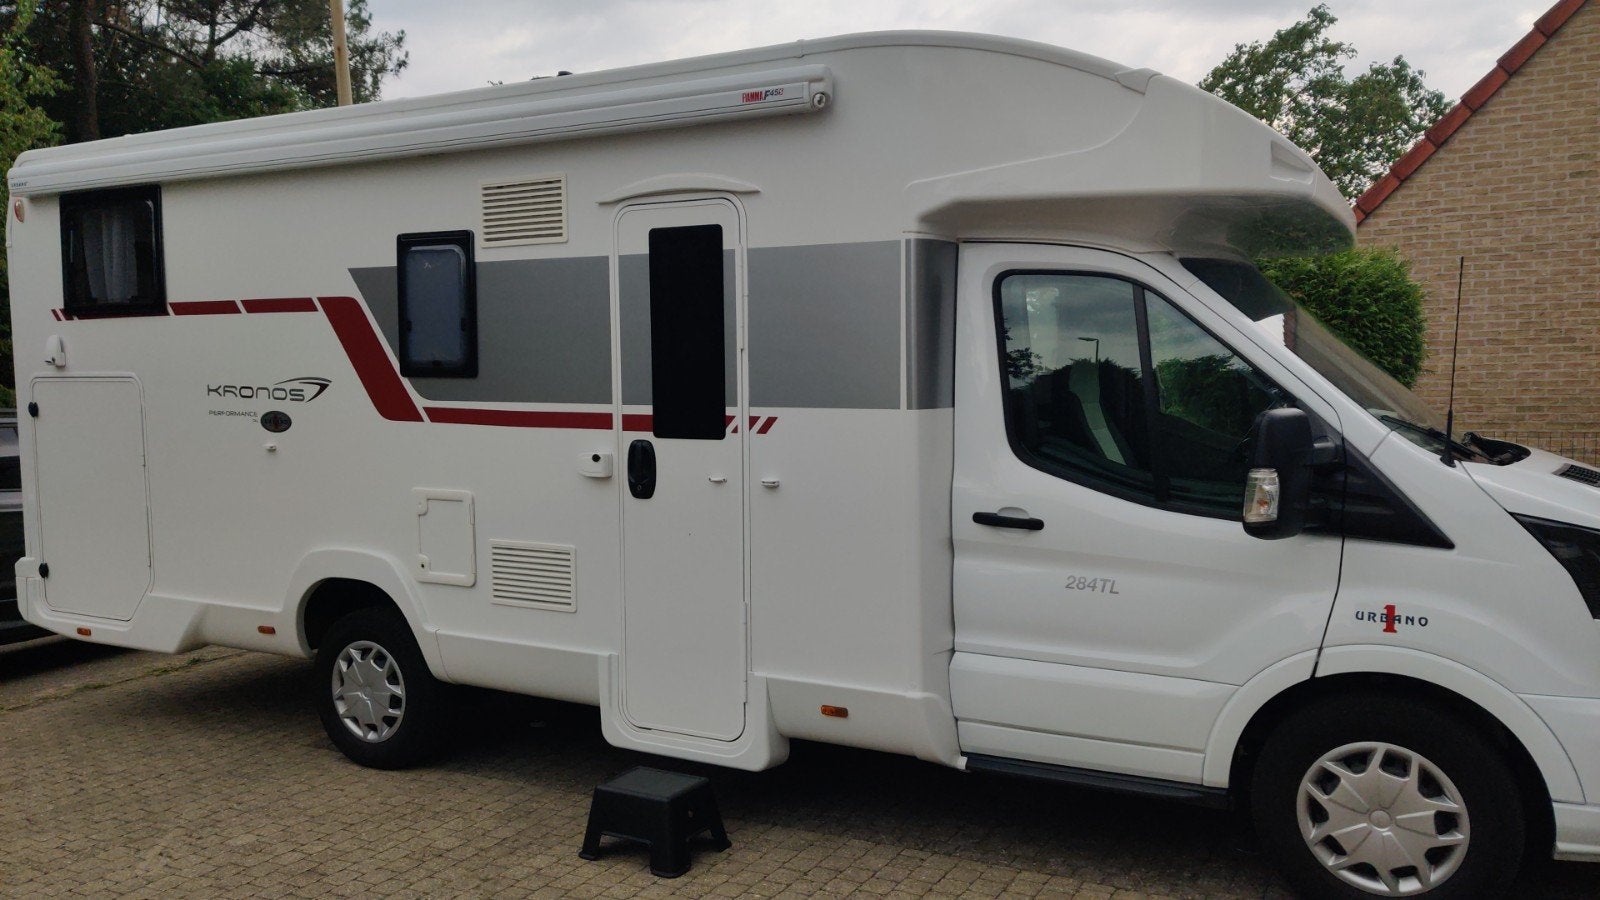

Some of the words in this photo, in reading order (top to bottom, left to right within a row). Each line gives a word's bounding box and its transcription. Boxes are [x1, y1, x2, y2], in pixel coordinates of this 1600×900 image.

[207, 384, 305, 402] KRONOS
[208, 410, 258, 418] PERFORMANCE
[1065, 575, 1119, 595] 284TL
[1355, 610, 1429, 627] URBANO
